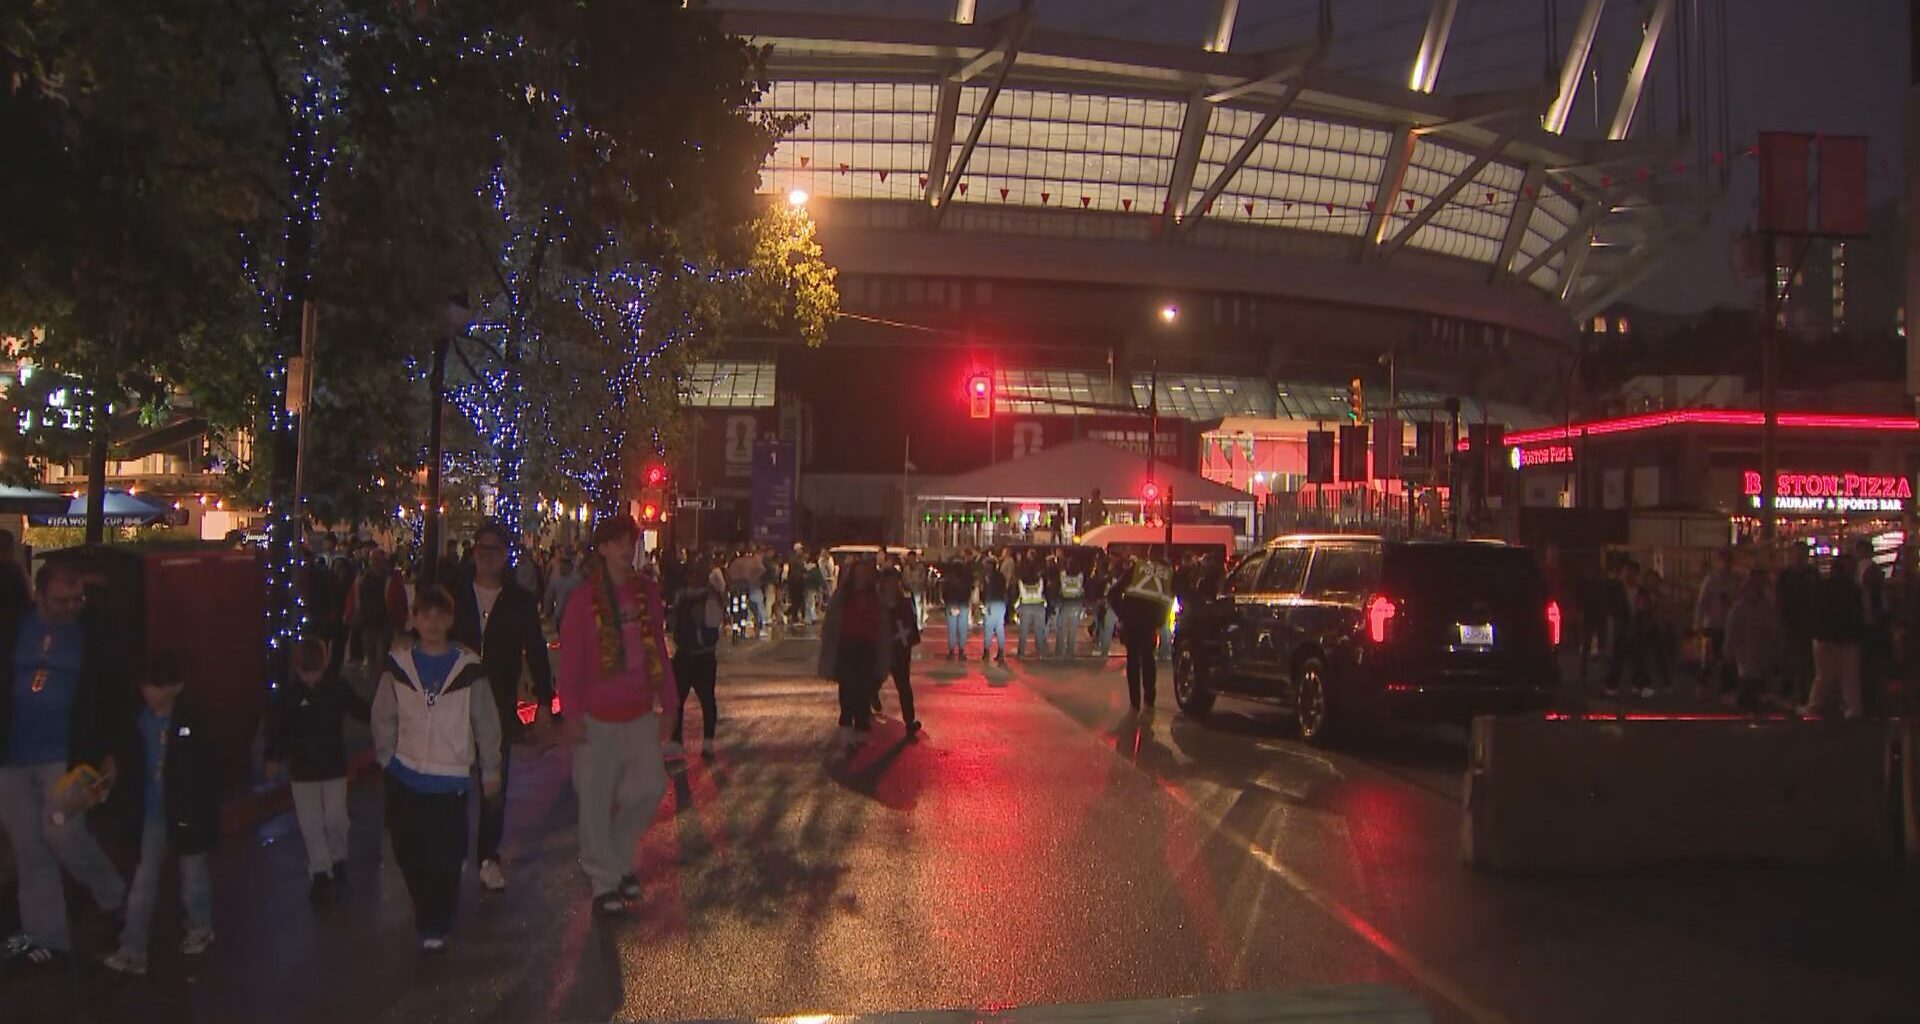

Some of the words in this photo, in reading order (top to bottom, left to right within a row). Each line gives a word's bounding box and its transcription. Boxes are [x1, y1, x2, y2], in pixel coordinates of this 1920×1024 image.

[1744, 472, 1840, 496] BSTON
[1844, 473, 1912, 498] PIZZA
[1751, 496, 1824, 509] RTAURANT
[1826, 498, 1835, 509] &
[1837, 498, 1879, 510] SPORTS
[1880, 499, 1903, 511] BAR
[47, 516, 70, 527] FIFA
